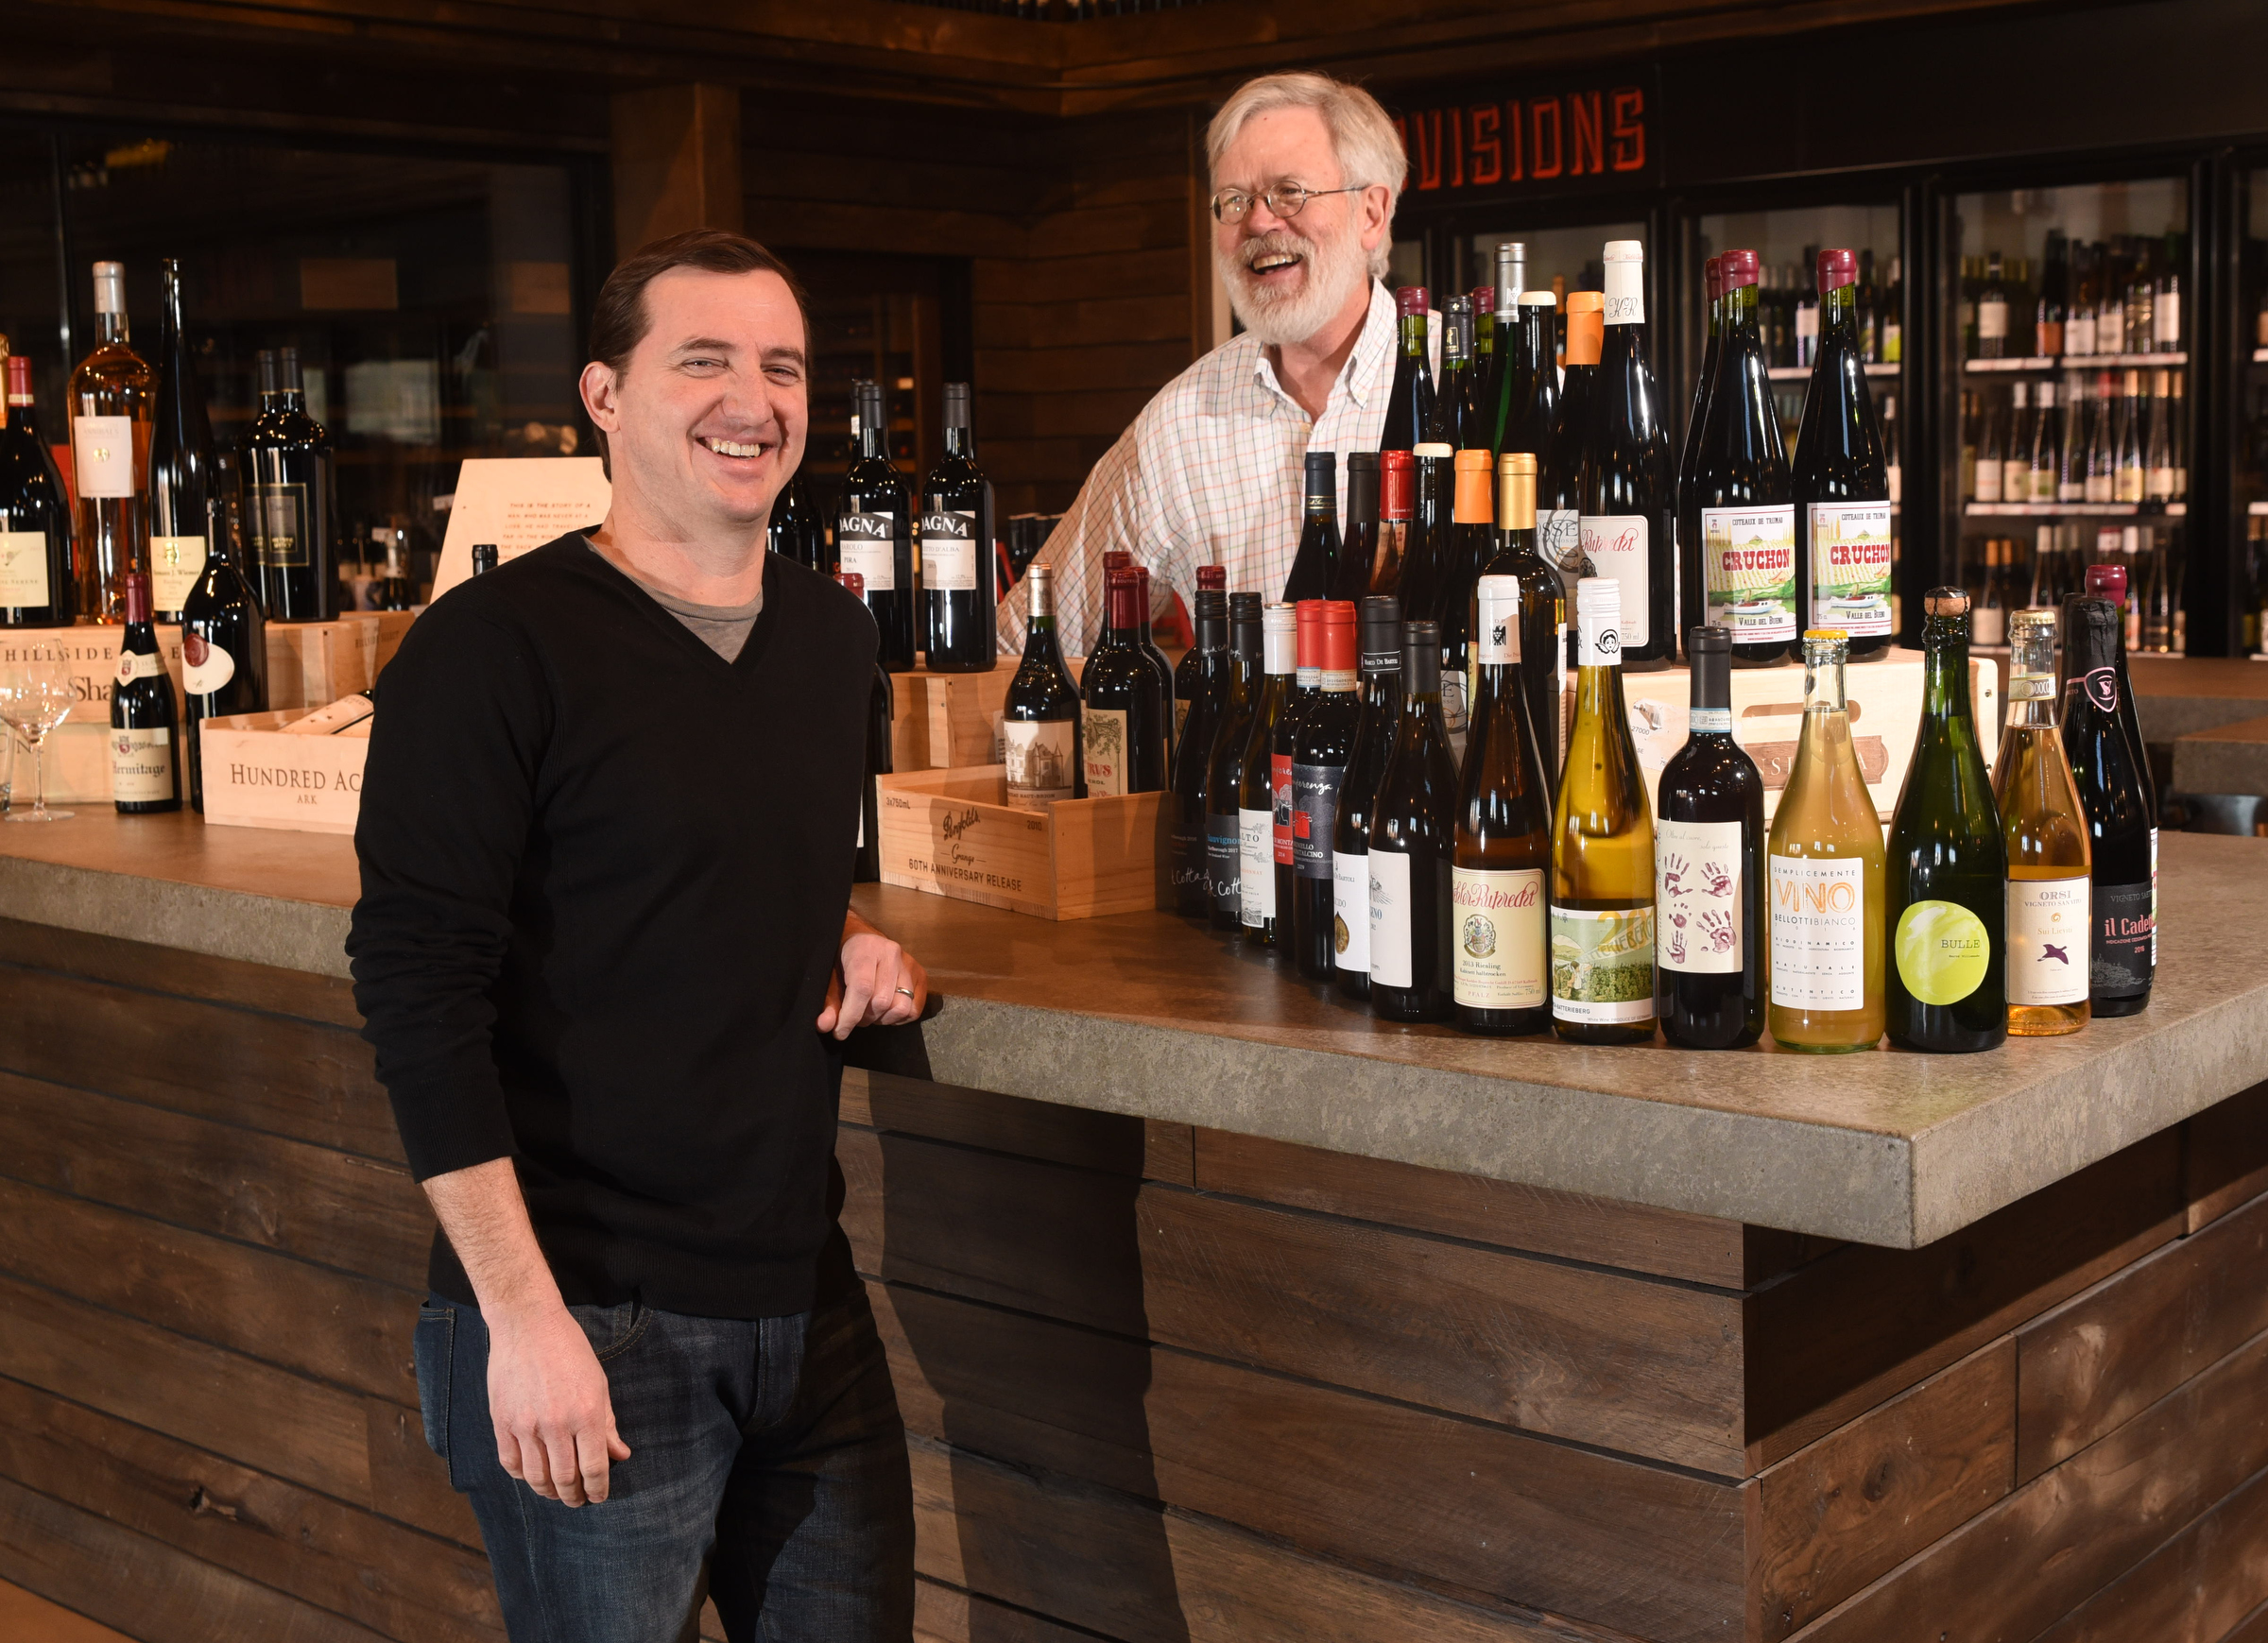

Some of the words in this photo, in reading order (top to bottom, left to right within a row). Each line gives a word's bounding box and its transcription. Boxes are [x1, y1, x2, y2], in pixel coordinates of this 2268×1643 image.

[1722, 548, 1791, 572] CRUCHON
[1830, 543, 1890, 565] CRUCHON
[231, 763, 327, 790] HUNDRED
[297, 794, 318, 805] ARK
[951, 843, 975, 866] Grange
[908, 858, 928, 872] 60TH
[930, 863, 985, 884] ANNIVERSARY
[986, 874, 1022, 892] RELEASE
[1774, 866, 1856, 878] SEMPLICEMENTE
[1775, 878, 1856, 915] VINO
[2038, 890, 2071, 901] ORSI
[2110, 893, 2141, 903] VIGNETO
[2104, 917, 2117, 937] il
[1940, 939, 1981, 949] BULLE
[1475, 961, 1502, 971] Riesling
[1775, 961, 1855, 970] NATURALE
